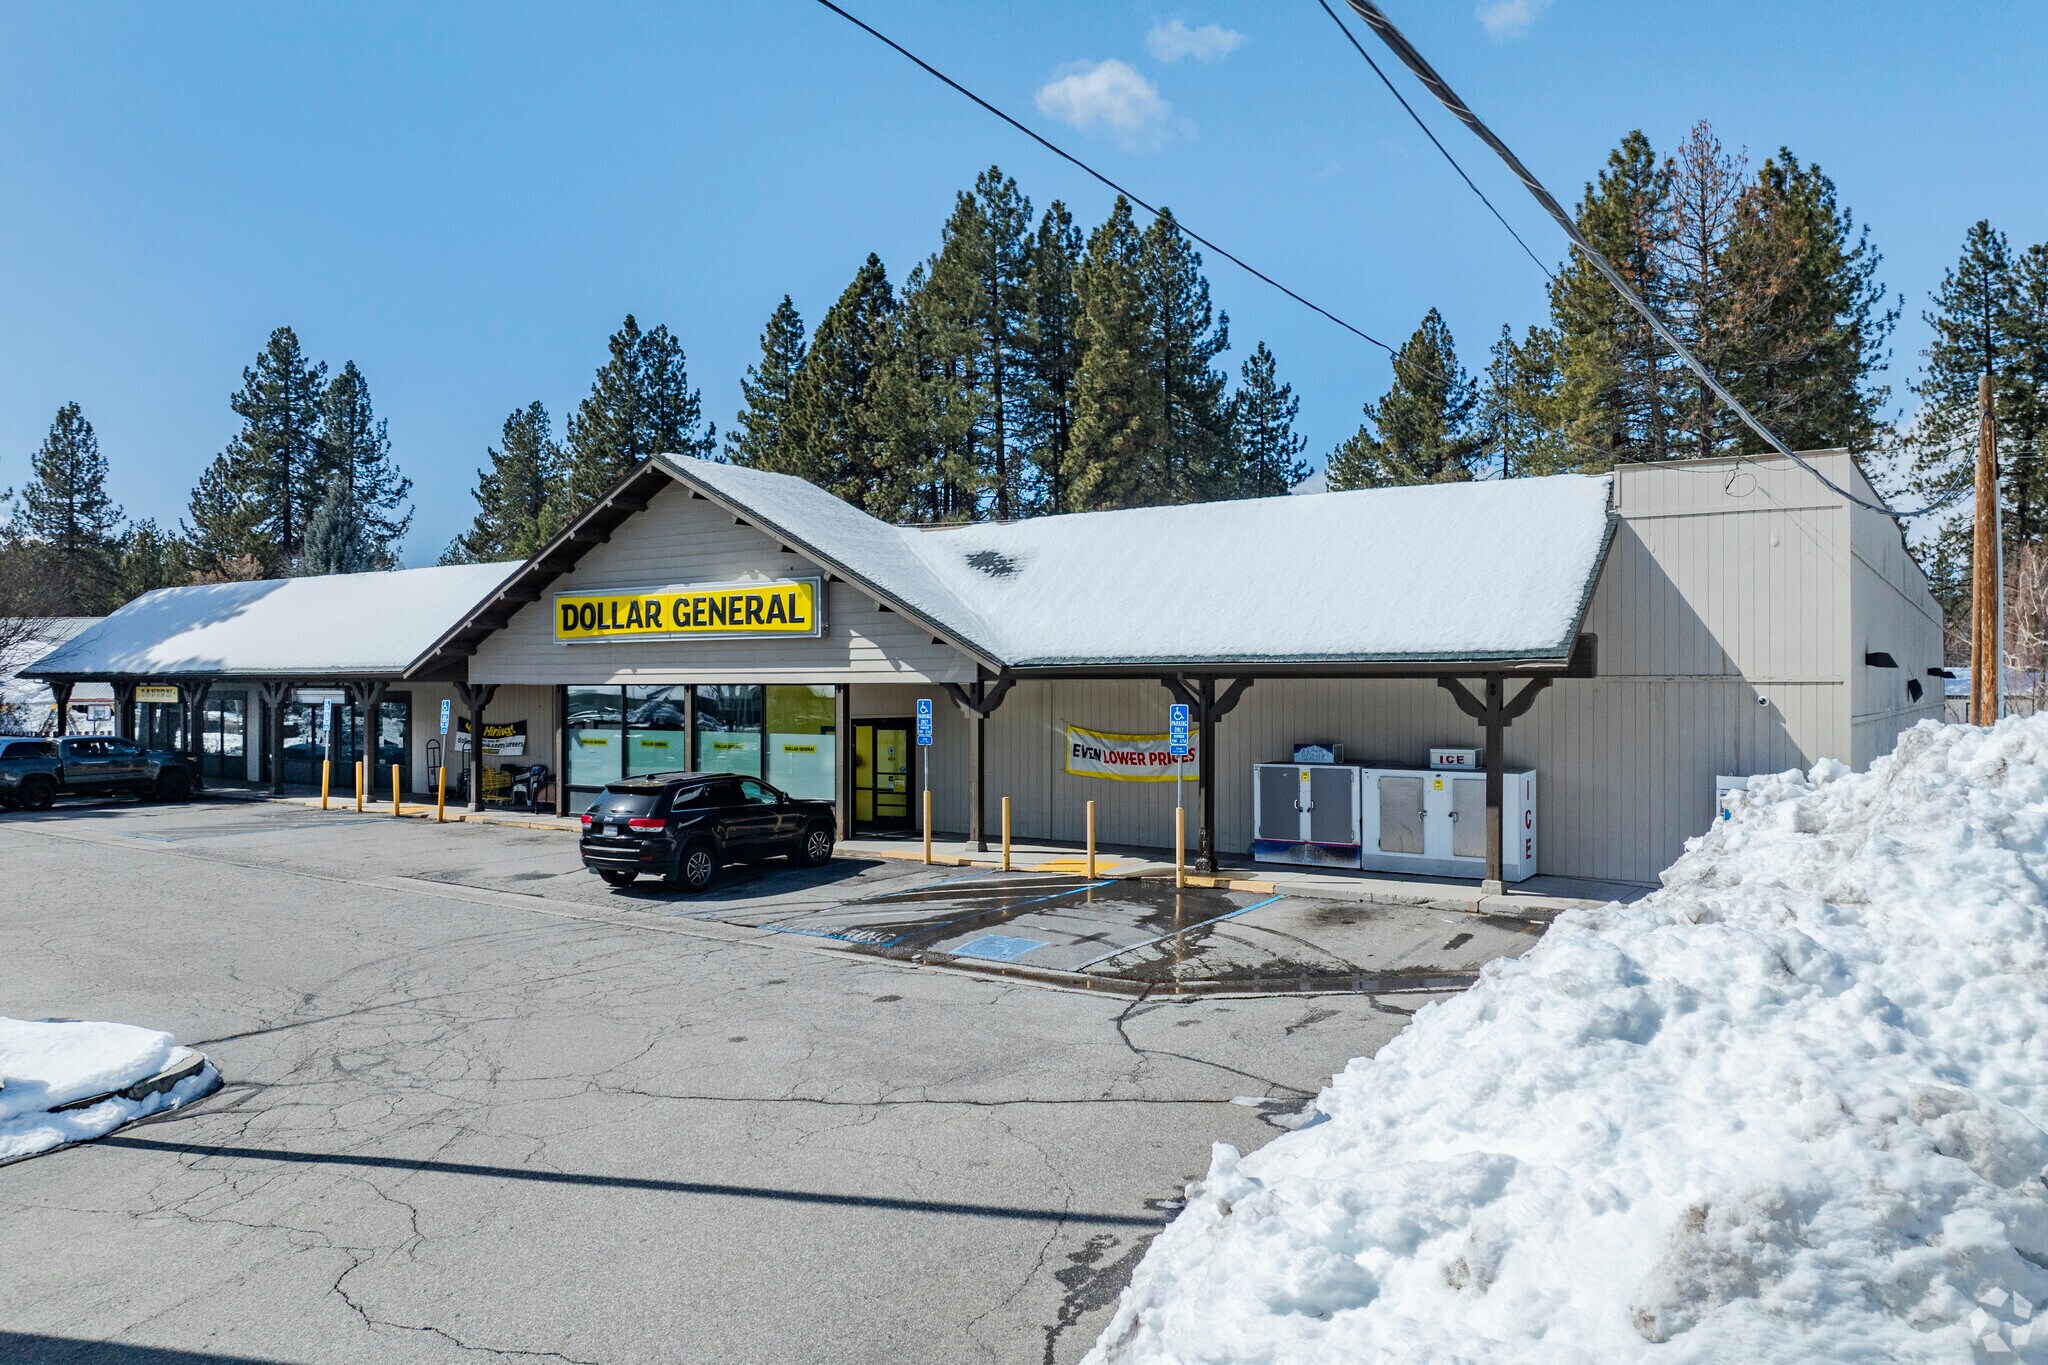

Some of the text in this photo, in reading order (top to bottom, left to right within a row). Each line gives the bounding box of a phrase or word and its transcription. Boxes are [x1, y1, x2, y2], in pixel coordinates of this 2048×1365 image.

[561, 592, 805, 632] DOLLAR GENERAL
[483, 724, 517, 737] Hiring!
[1072, 743, 1102, 761] EVEN
[1102, 750, 1147, 765] LOWER
[1439, 755, 1465, 765] ICE
